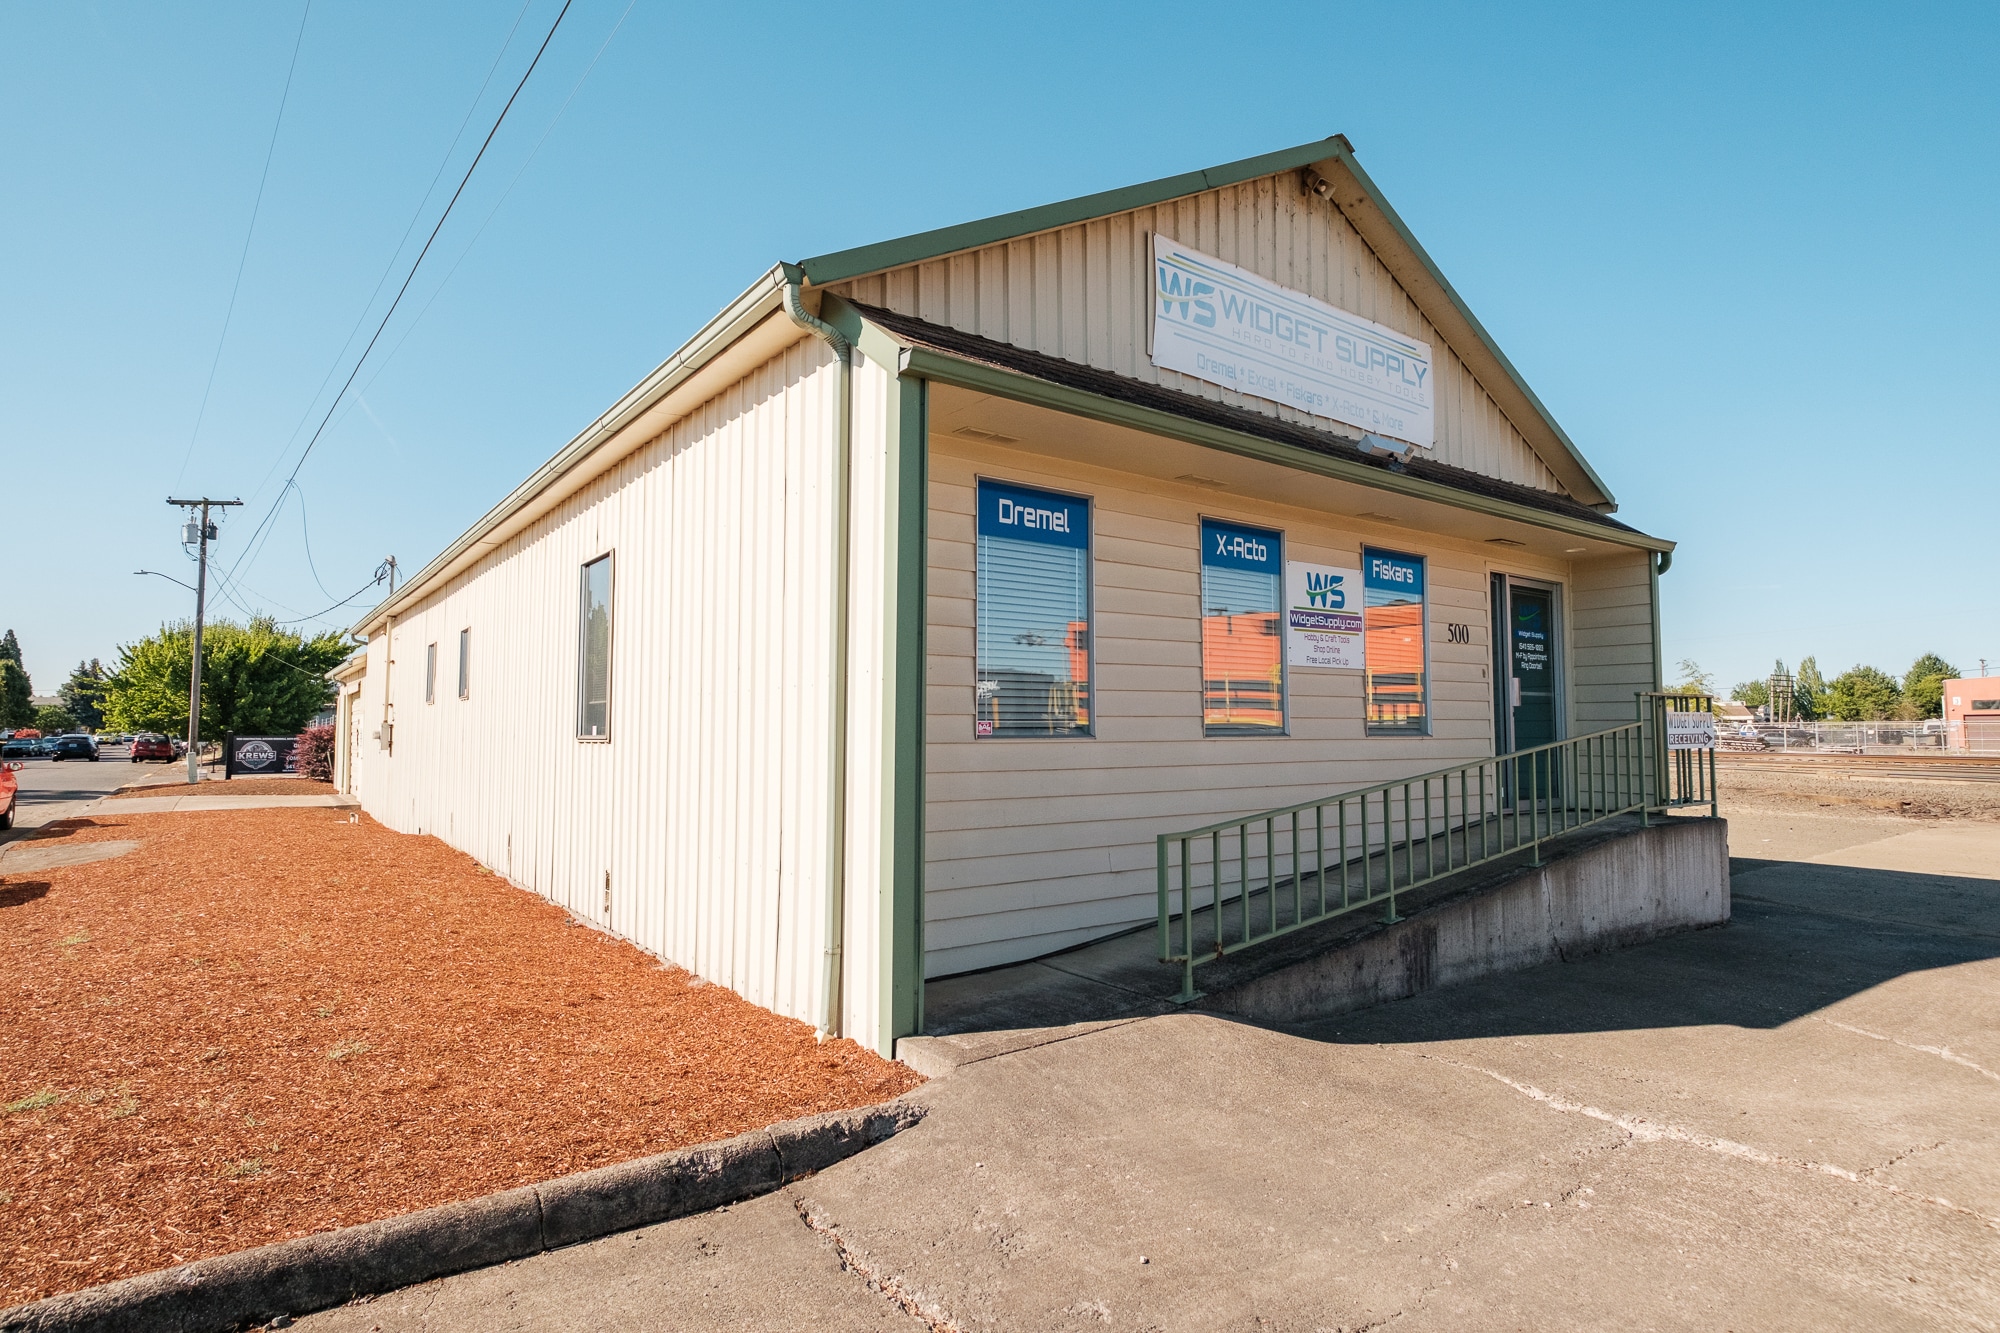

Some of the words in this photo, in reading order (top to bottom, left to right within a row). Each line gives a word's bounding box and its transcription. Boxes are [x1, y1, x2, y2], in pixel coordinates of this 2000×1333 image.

[1158, 267, 1216, 328] WS
[1219, 289, 1329, 353] WIDGET
[1335, 335, 1428, 388] SUPPLY
[1232, 327, 1272, 349] HARD
[1280, 344, 1296, 358] TO
[1304, 353, 1333, 371] FIND
[1340, 366, 1381, 385] HOBBY
[1388, 382, 1425, 402] TOOLS
[1197, 352, 1237, 380] Dremel
[1248, 369, 1277, 393] Excel
[1286, 381, 1323, 407] Fiskars
[1332, 395, 1365, 419] X-Acto
[1382, 414, 1404, 431] More
[999, 498, 1070, 533] Dremel
[1216, 534, 1267, 562] X-Acto
[1372, 559, 1414, 584] Fiskars
[1306, 571, 1346, 609] WS
[1290, 613, 1362, 630] WidgetSupply.com
[1447, 623, 1470, 644] 500
[1304, 633, 1319, 643] Hobby
[1325, 635, 1337, 643] Craft
[1338, 635, 1350, 644] Tools
[1313, 645, 1325, 654] Shop
[1306, 655, 1317, 664] Free
[1318, 656, 1331, 665] Local
[1332, 657, 1341, 665] Pick
[1667, 713, 1690, 728] WIDGET
[1692, 713, 1712, 728] SUPPLY
[1669, 735, 1709, 744] RECEIVING
